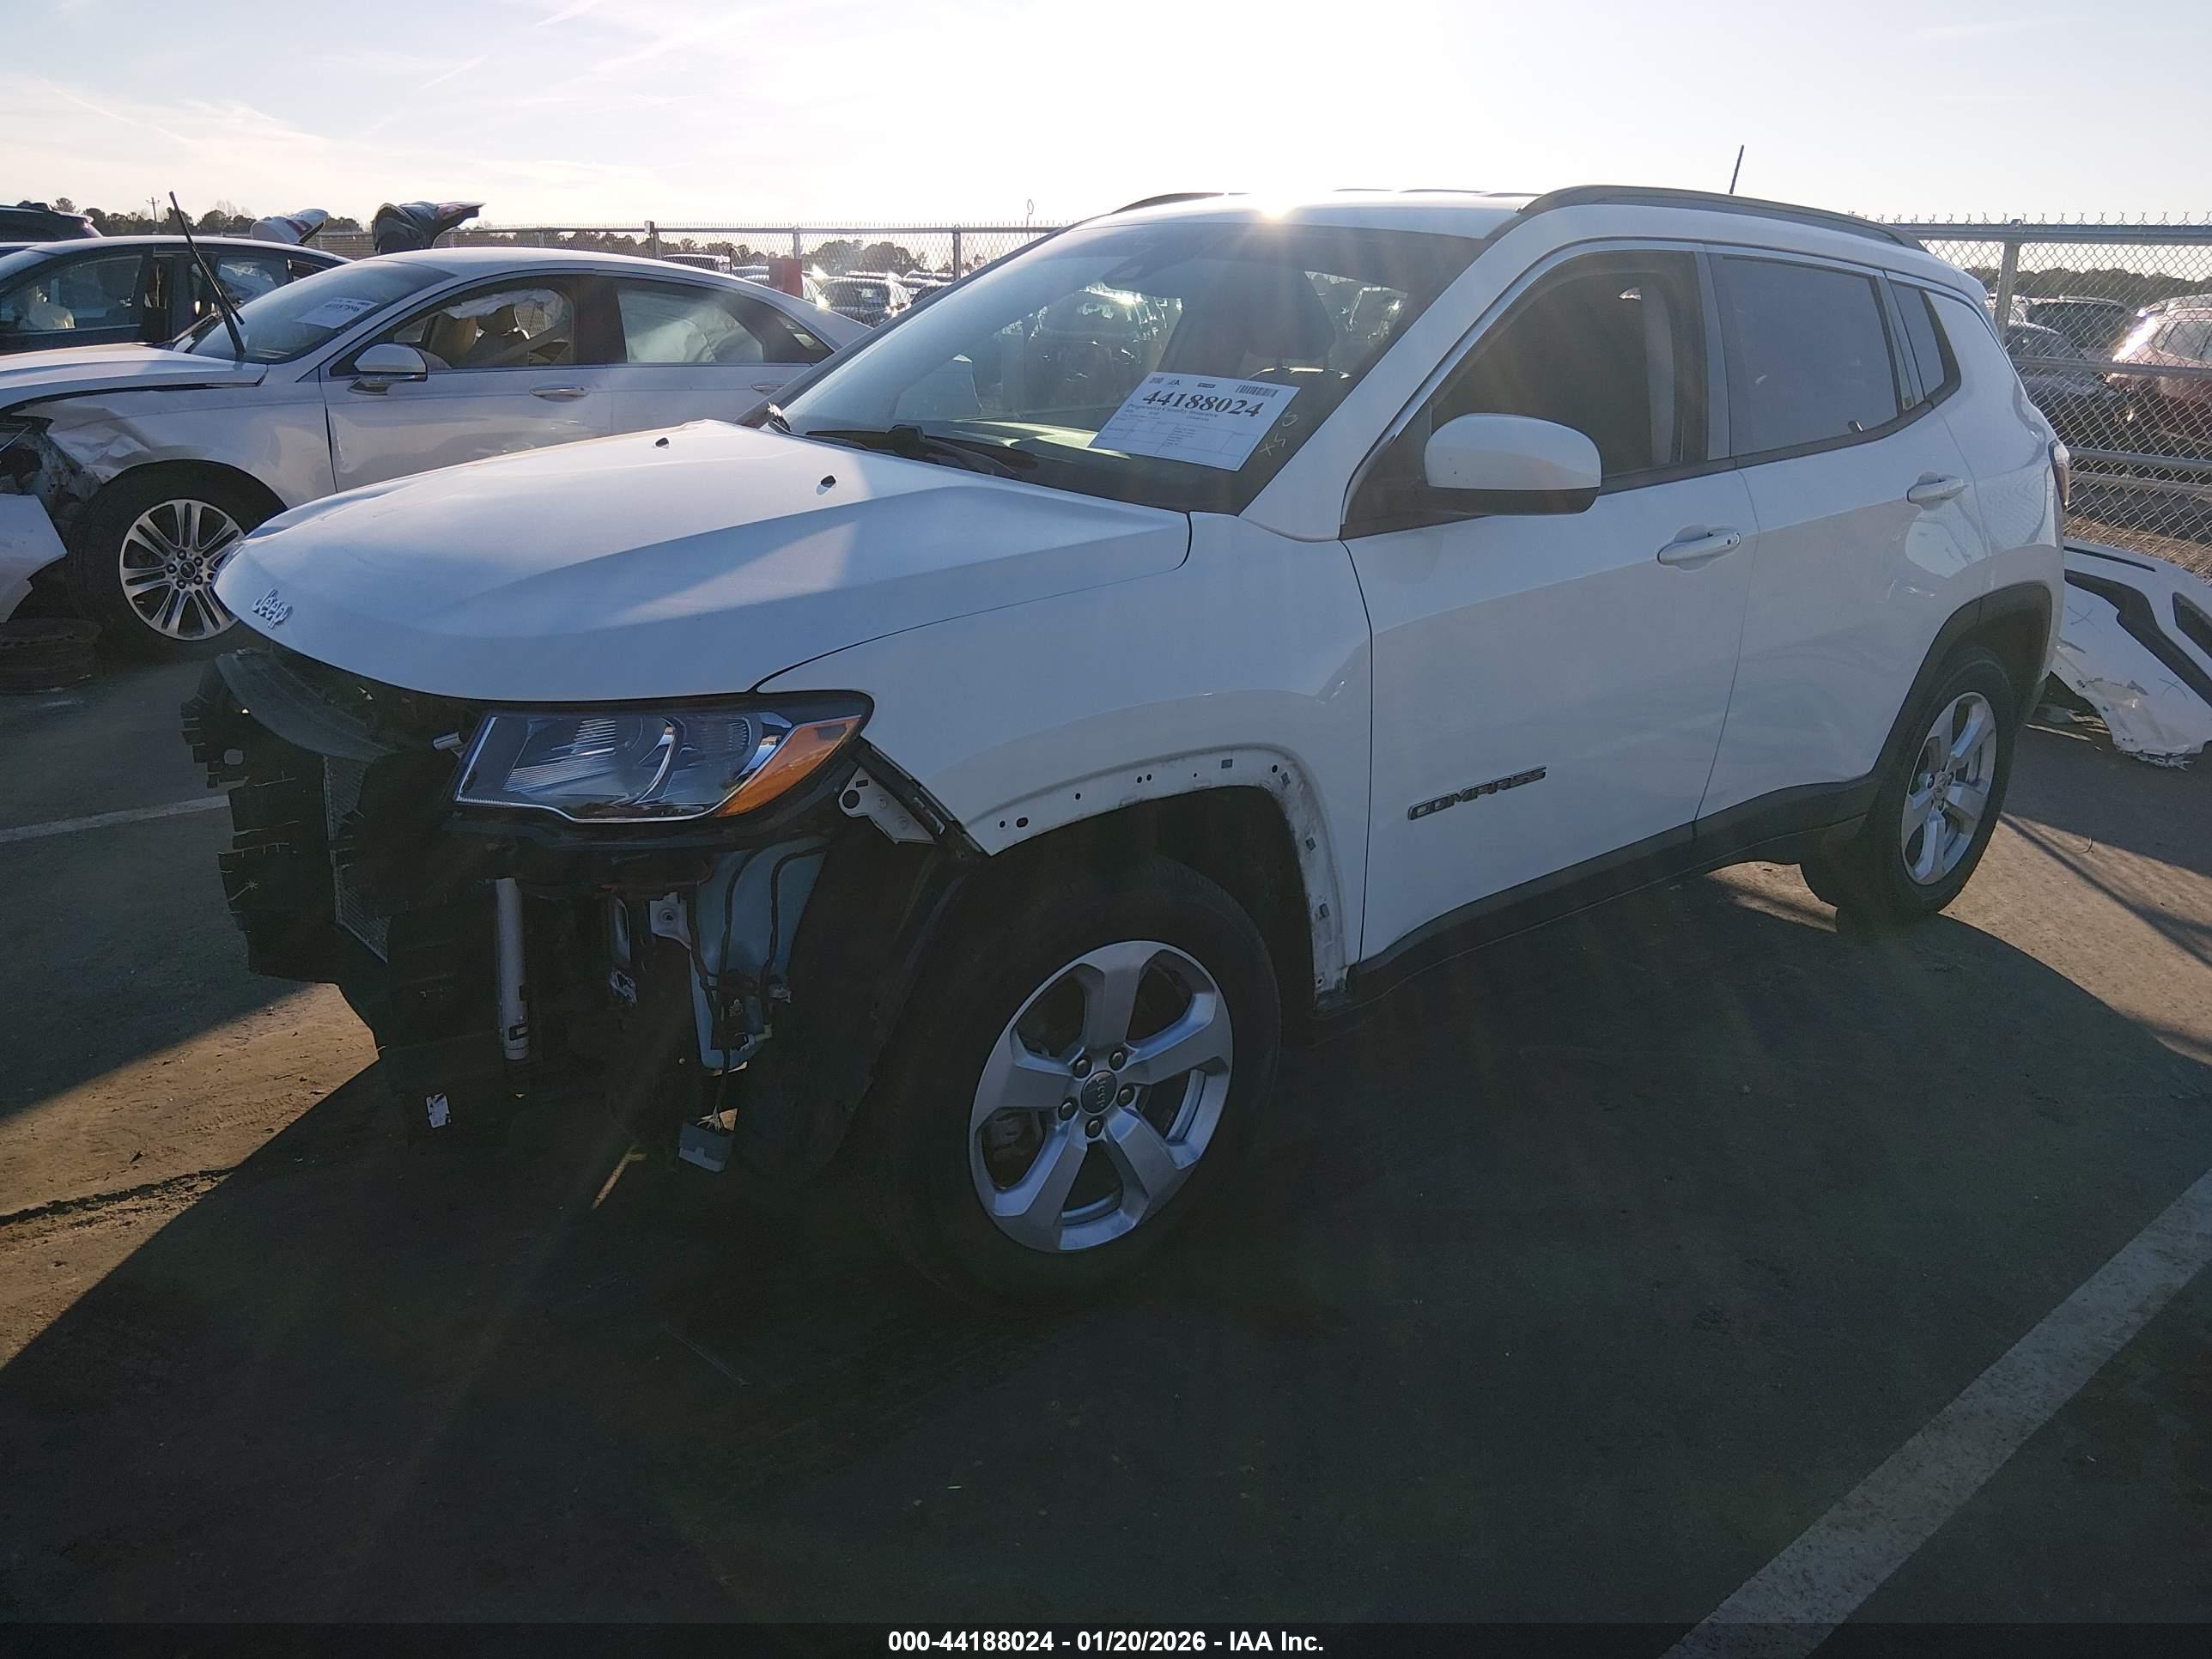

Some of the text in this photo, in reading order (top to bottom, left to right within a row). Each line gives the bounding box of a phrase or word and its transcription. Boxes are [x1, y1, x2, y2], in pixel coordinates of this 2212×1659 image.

[1143, 390, 1264, 416] 44188024
[252, 589, 292, 629] Jeep
[1407, 765, 1547, 821] COMPASS
